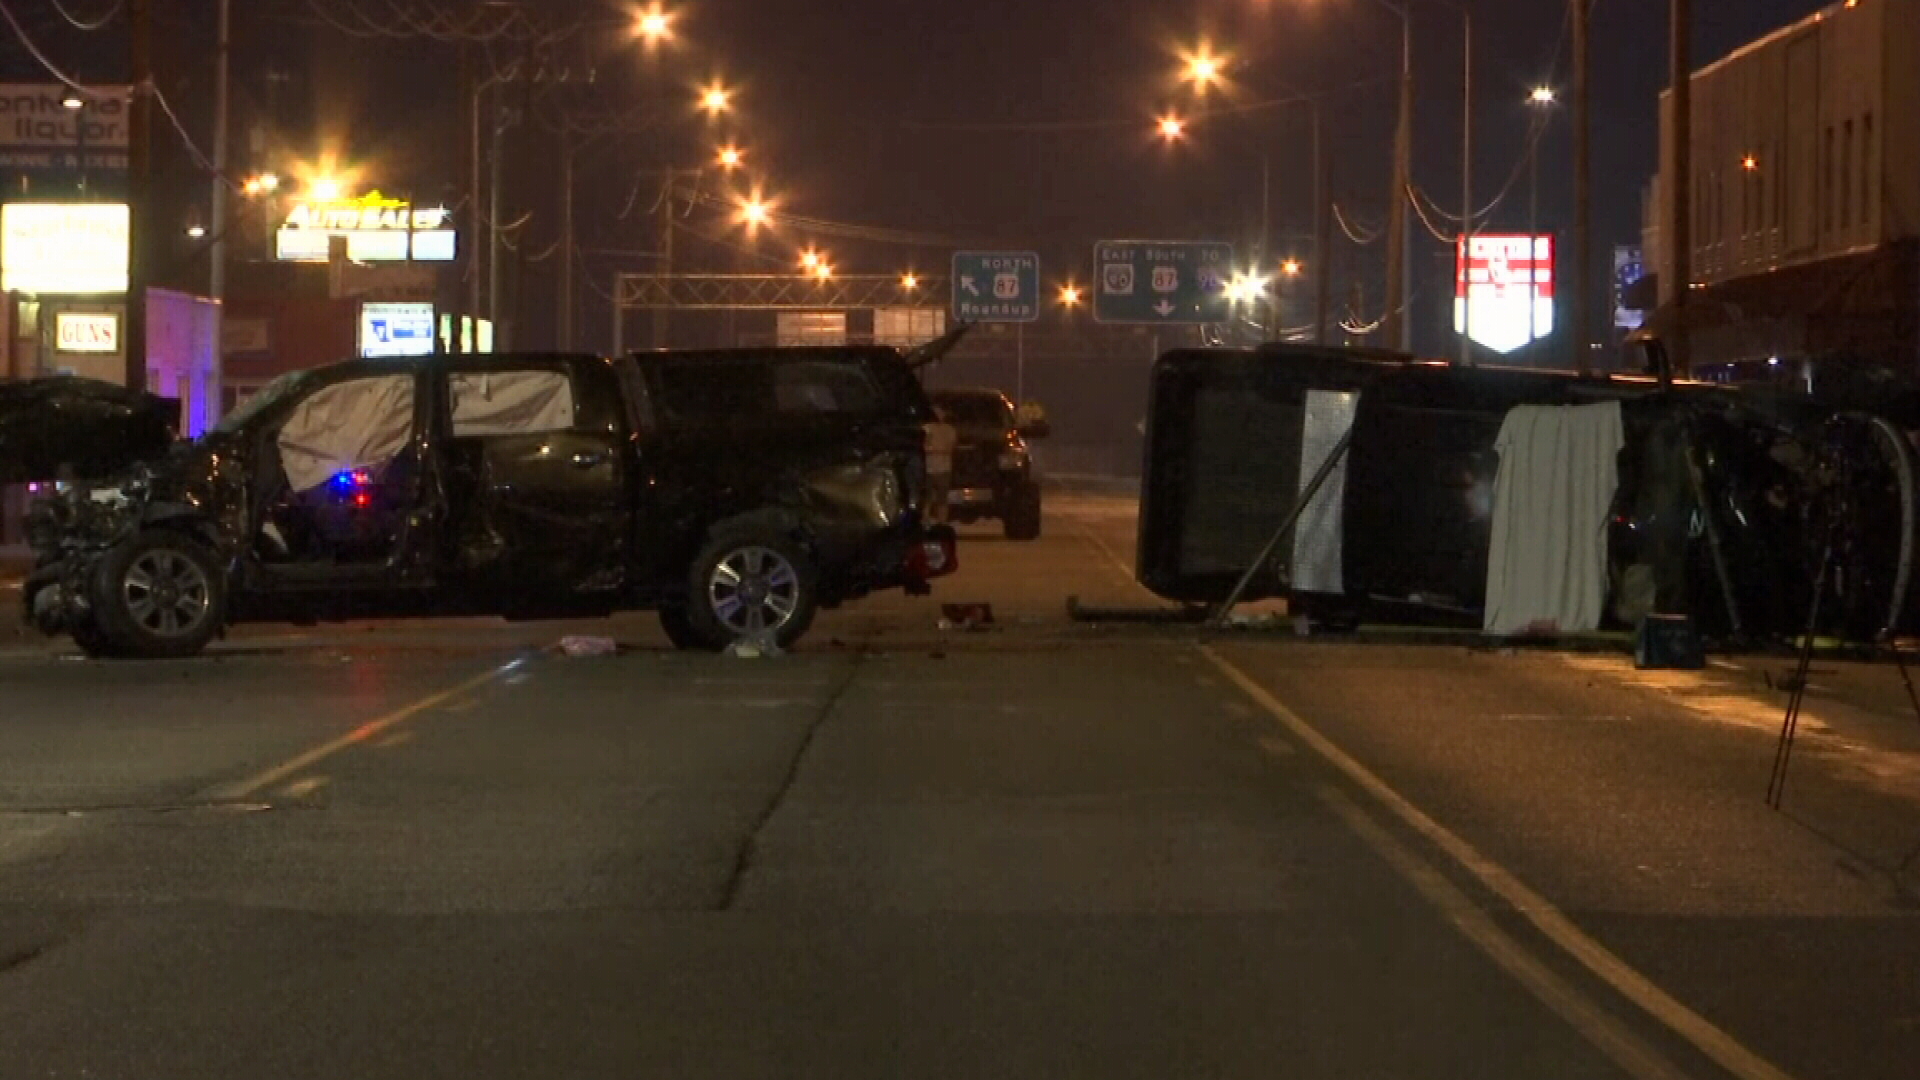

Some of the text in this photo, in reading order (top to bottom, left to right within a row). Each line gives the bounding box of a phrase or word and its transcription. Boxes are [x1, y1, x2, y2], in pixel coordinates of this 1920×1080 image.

[981, 257, 1033, 269] NORTH
[961, 302, 1031, 316] Roundup
[62, 322, 112, 345] GUNS
